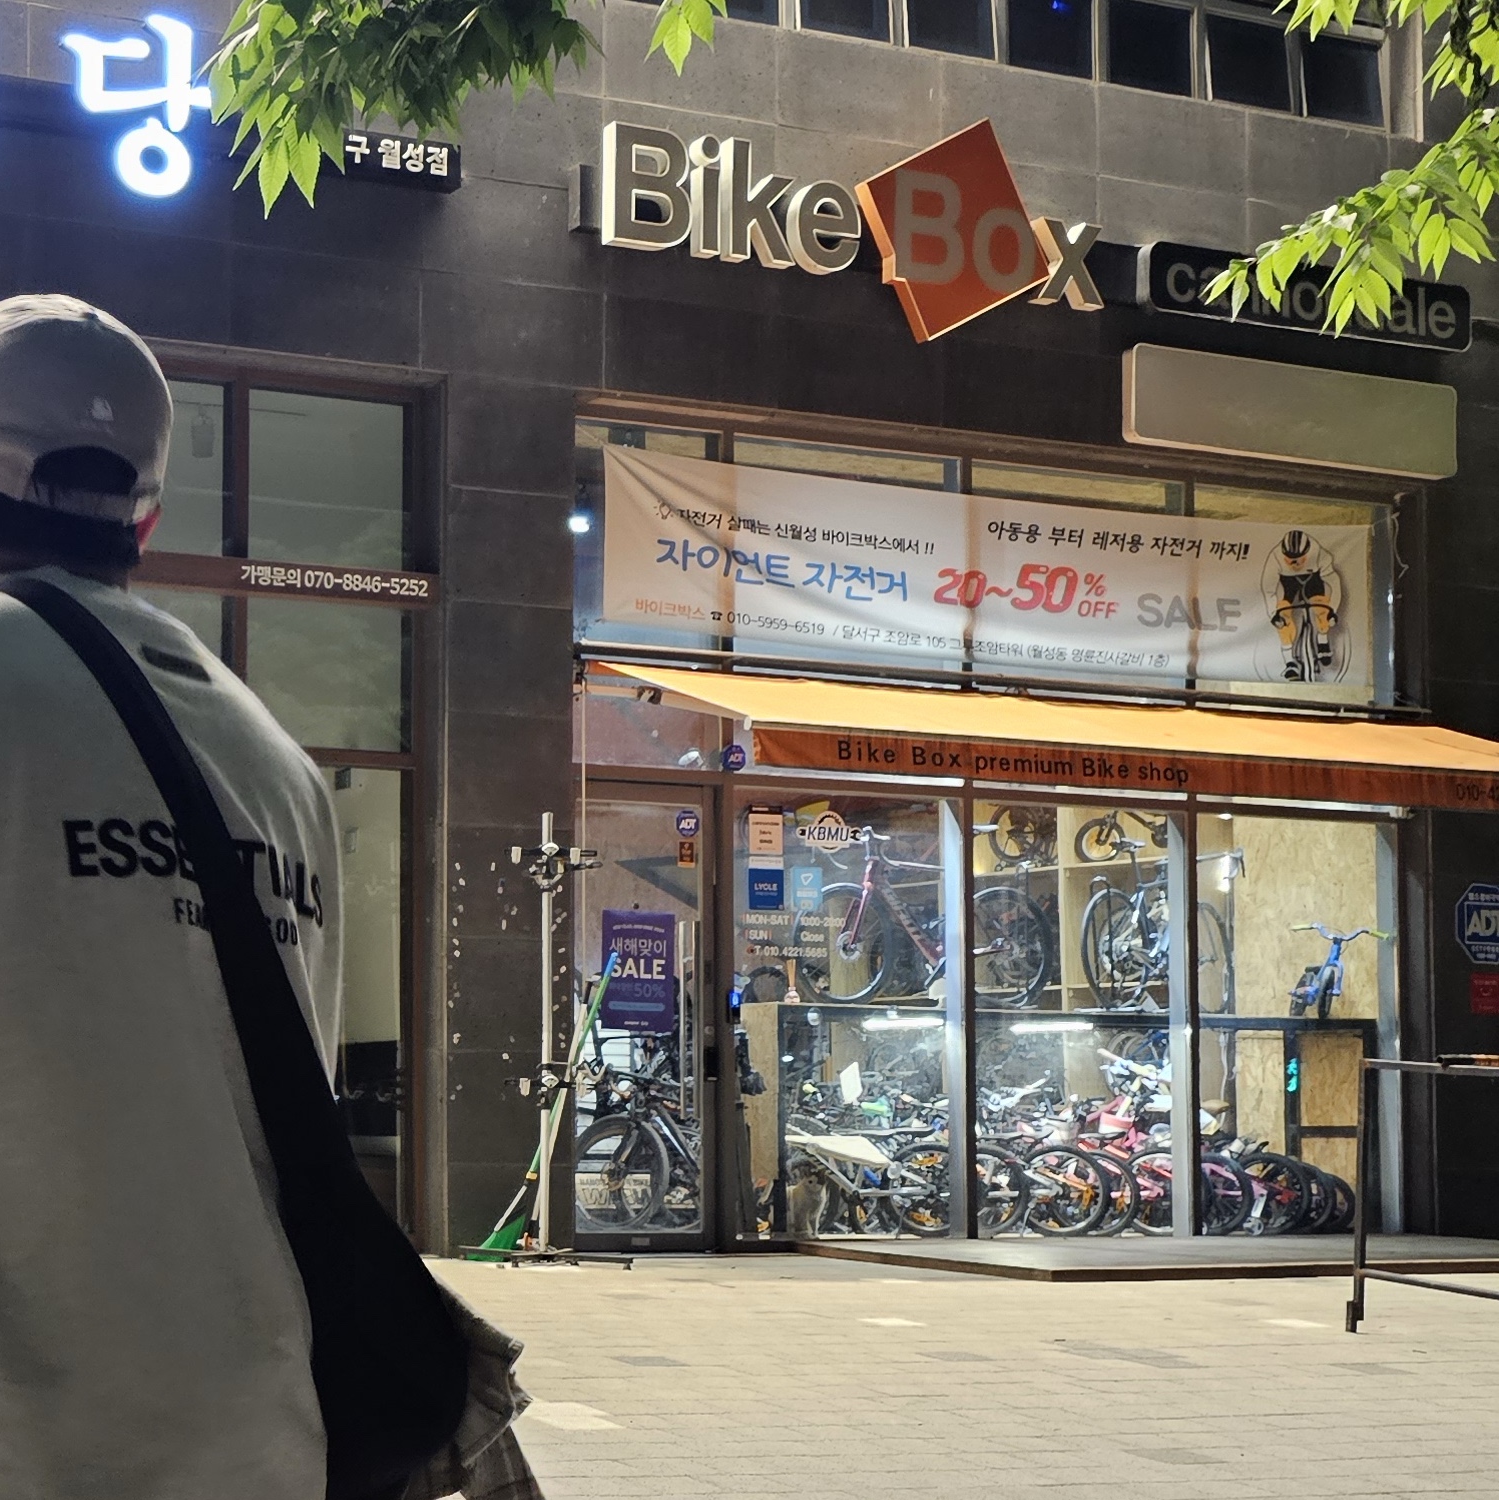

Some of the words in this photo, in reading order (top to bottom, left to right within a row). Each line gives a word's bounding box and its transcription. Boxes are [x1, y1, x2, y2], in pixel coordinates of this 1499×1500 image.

[345, 134, 371, 164] 구
[377, 138, 449, 177] 월성점
[602, 120, 861, 275] Bike
[896, 166, 1104, 312] Box
[678, 508, 722, 529] 자전거
[727, 515, 771, 536] 살때는
[774, 522, 818, 542] 신월성
[821, 528, 920, 555] 바이크박스에서
[987, 520, 1042, 545] 아동용
[1048, 526, 1086, 549] 부터
[1092, 530, 1145, 555] 레저용
[1150, 535, 1203, 559] 자전거
[240, 564, 302, 588] 가맹문의
[304, 569, 429, 597] 070-8846-5252
[656, 538, 796, 588] 자이언트
[802, 561, 909, 602] 자전거
[933, 562, 1108, 613] 20~50%
[635, 598, 706, 621] 바이크박스
[726, 611, 826, 636] 010-5959-6519
[842, 625, 882, 642] 달서구
[884, 630, 922, 647] 조암로
[926, 636, 947, 649] 105
[949, 638, 1023, 657] 그조암타워
[1077, 600, 1119, 619] OFF
[1137, 591, 1242, 633] SALE
[728, 753, 744, 763] ADT
[837, 739, 897, 764] Bike
[912, 746, 962, 768] Box
[974, 752, 1074, 778] premium
[1082, 757, 1129, 780] Bike
[1137, 763, 1190, 787] shop
[679, 818, 697, 830] ADT
[807, 826, 850, 842] KBMU
[609, 937, 667, 957] 새해맞이
[749, 930, 769, 941] SUN
[801, 931, 825, 943] Close
[610, 957, 666, 980] SALE
[634, 983, 666, 998] 50%
